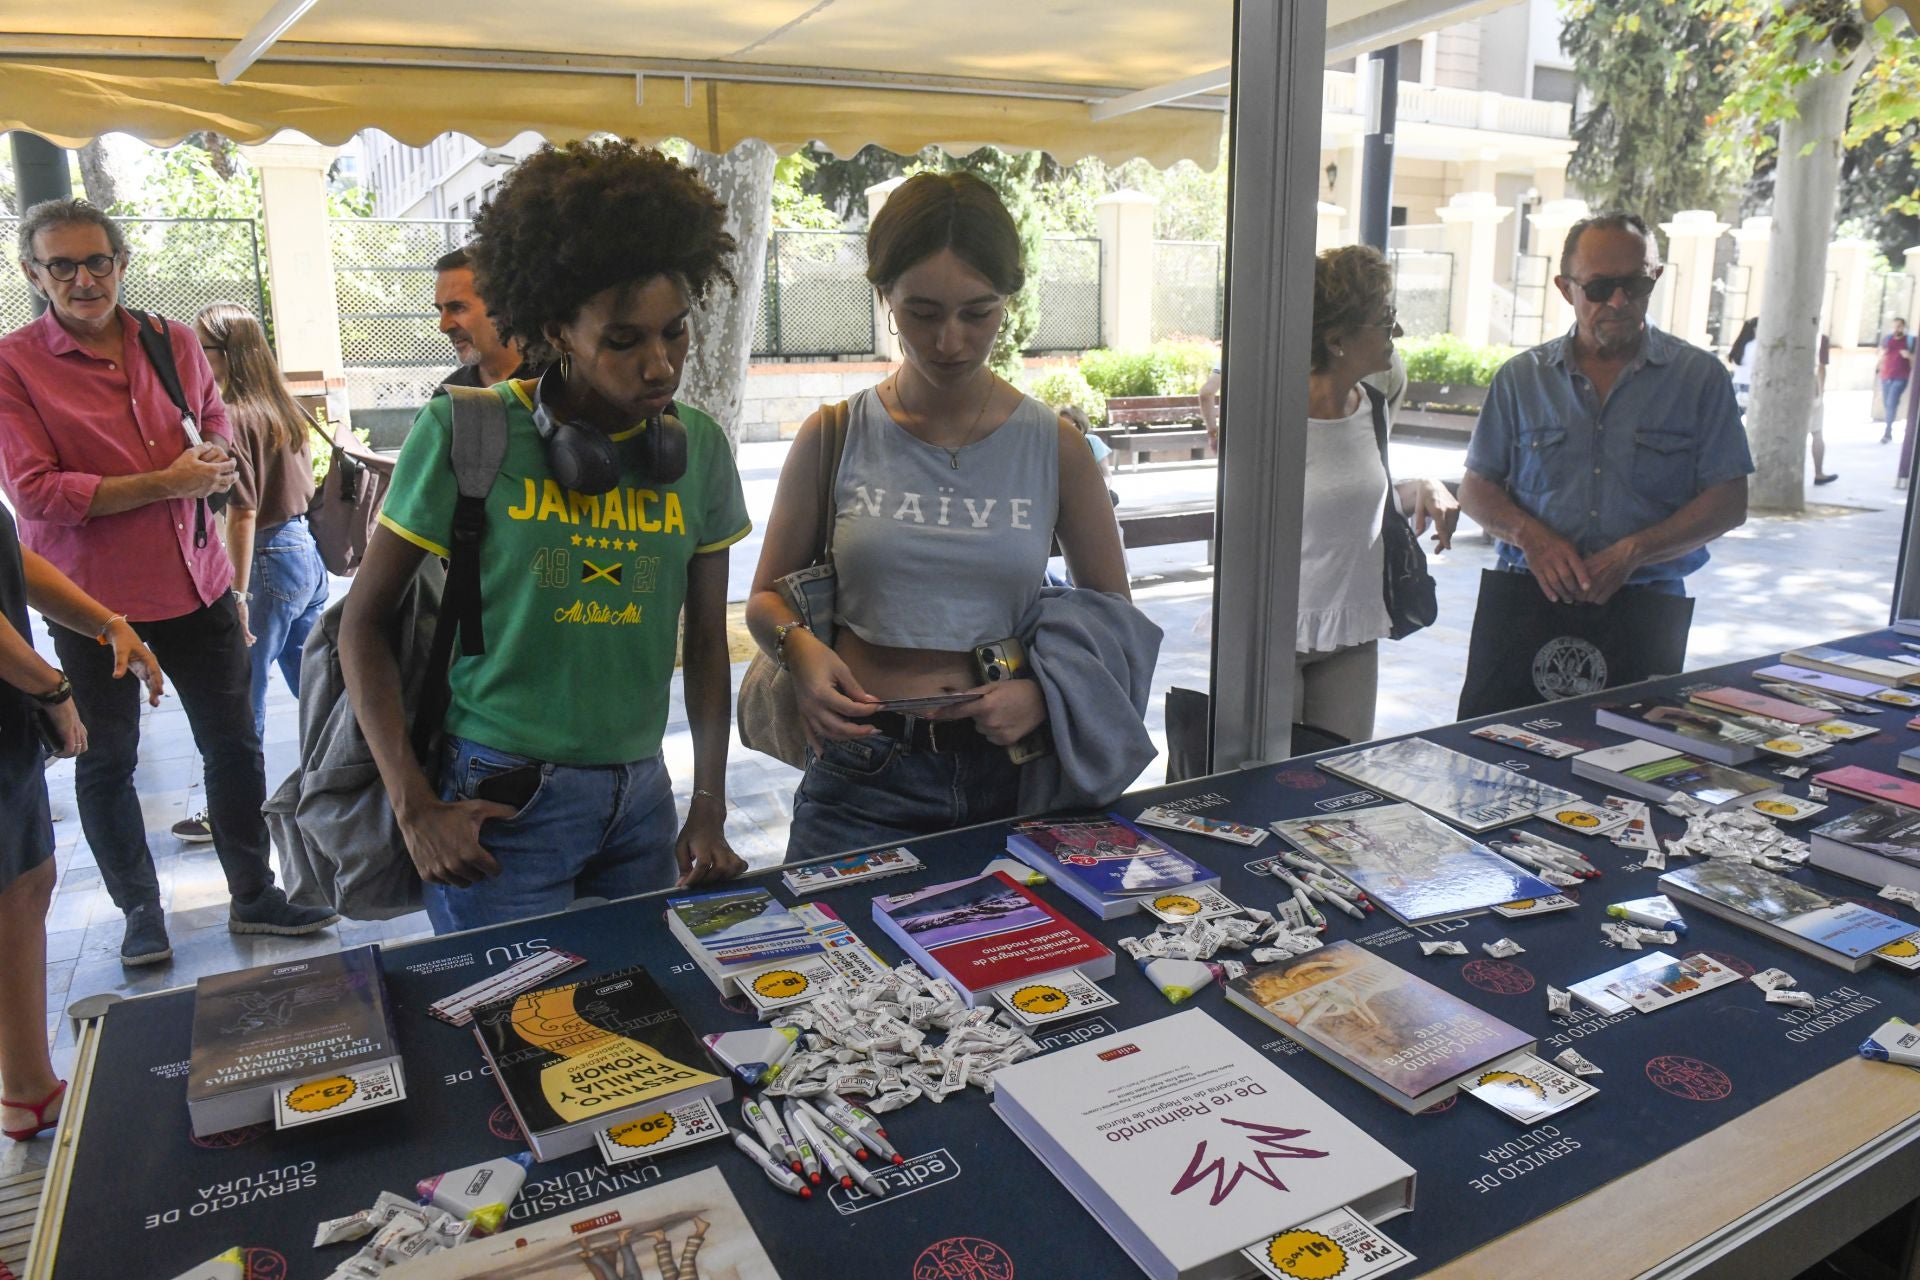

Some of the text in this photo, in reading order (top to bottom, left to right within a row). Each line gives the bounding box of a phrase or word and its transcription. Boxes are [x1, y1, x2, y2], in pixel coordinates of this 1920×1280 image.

[508, 477, 686, 536] JAMAICA
[854, 486, 1032, 530] NAÏVE
[529, 546, 662, 593] 48 21
[554, 600, 582, 623] All
[582, 600, 611, 625] State
[1522, 718, 1562, 730] SIU
[1497, 759, 1529, 771] SI
[982, 929, 1071, 954] islandés moderno
[1028, 936, 1079, 952] Gramática
[1068, 943, 1088, 952] Rafael
[485, 938, 550, 965] SIU
[987, 948, 1027, 962] integral
[1044, 949, 1066, 957] García
[405, 952, 472, 970] UNIVERSITARIO
[412, 956, 473, 972] INFORMACIÓN
[434, 960, 474, 971] SERVICIO
[670, 962, 693, 973] DE
[1080, 996, 1102, 1005] PVP
[1829, 986, 1860, 1000] DE
[1785, 995, 1881, 1042] UNIVERSIDAD
[1413, 1022, 1446, 1038] arte
[234, 1034, 351, 1063] TARDOMEDIEVAL
[1403, 1027, 1500, 1070] Italo Calvino
[1545, 1033, 1571, 1047] DE
[216, 1037, 369, 1075] EN LA ESCANDINAVIA
[331, 1042, 381, 1059] LIBROS
[620, 1046, 633, 1054] EN
[1383, 1033, 1450, 1066] frontera
[308, 1054, 326, 1064] DE
[567, 1054, 607, 1072] MEDIEVO
[569, 1052, 651, 1083] HONOR
[443, 1070, 472, 1084] DE
[560, 1062, 673, 1102] FAMILIA Y
[362, 1088, 392, 1100] PVP
[1557, 1081, 1578, 1094] PVP
[1096, 1075, 1252, 1131] La cocina de la Región de Murcia
[1105, 1082, 1267, 1143] De re Raimundo
[681, 1117, 709, 1129] -10%
[685, 1122, 713, 1135] PVP
[1480, 1125, 1560, 1163] CULTURA
[1468, 1137, 1581, 1192] SERVICIO DE
[198, 1160, 315, 1198] CULTURA
[518, 1163, 607, 1200] MURCI
[509, 1165, 661, 1219] UNIVERSID
[144, 1174, 316, 1228] SERVICIO DE
[1344, 1233, 1370, 1246] DESCUENTO
[1349, 1238, 1376, 1254] -10%
[1363, 1245, 1391, 1262] PVP
